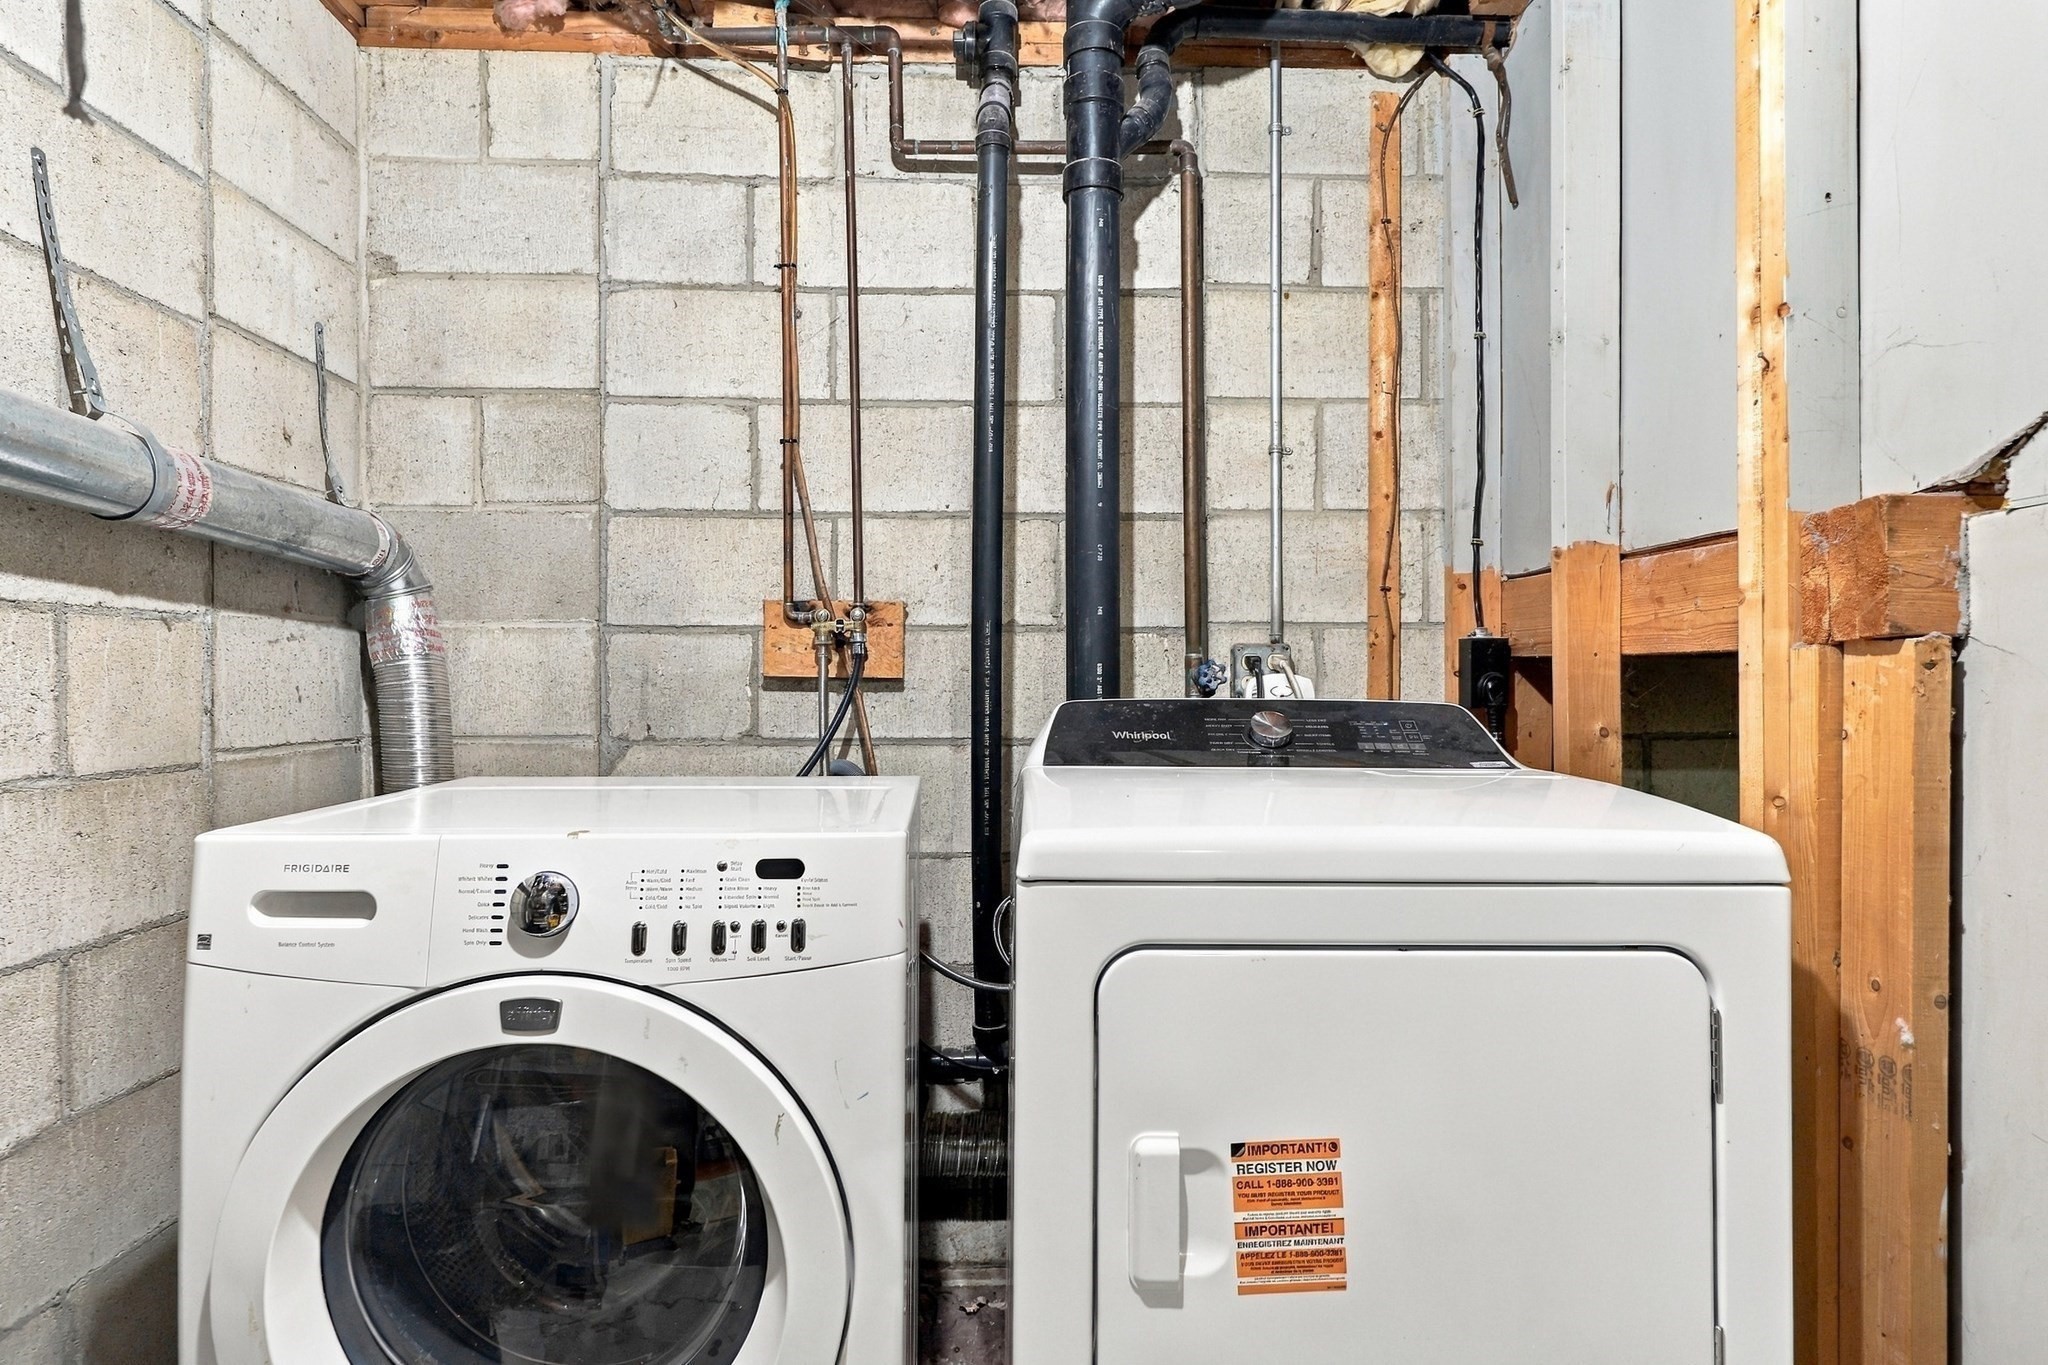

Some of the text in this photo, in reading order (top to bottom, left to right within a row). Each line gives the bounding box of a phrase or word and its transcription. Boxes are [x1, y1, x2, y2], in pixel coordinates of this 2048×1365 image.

[1112, 730, 1171, 741] Whirlpool
[284, 864, 350, 872] FRIGIDAIRE
[1247, 1142, 1326, 1156] IMPORTANT!
[1236, 1160, 1337, 1175] REGISTER NOW
[1236, 1180, 1264, 1190] CALL
[1245, 1223, 1334, 1237] IMPORTANTE!
[1238, 1238, 1344, 1248] ENREGISTREZ MAINTENANT
[1240, 1251, 1275, 1260] APPELEZ
